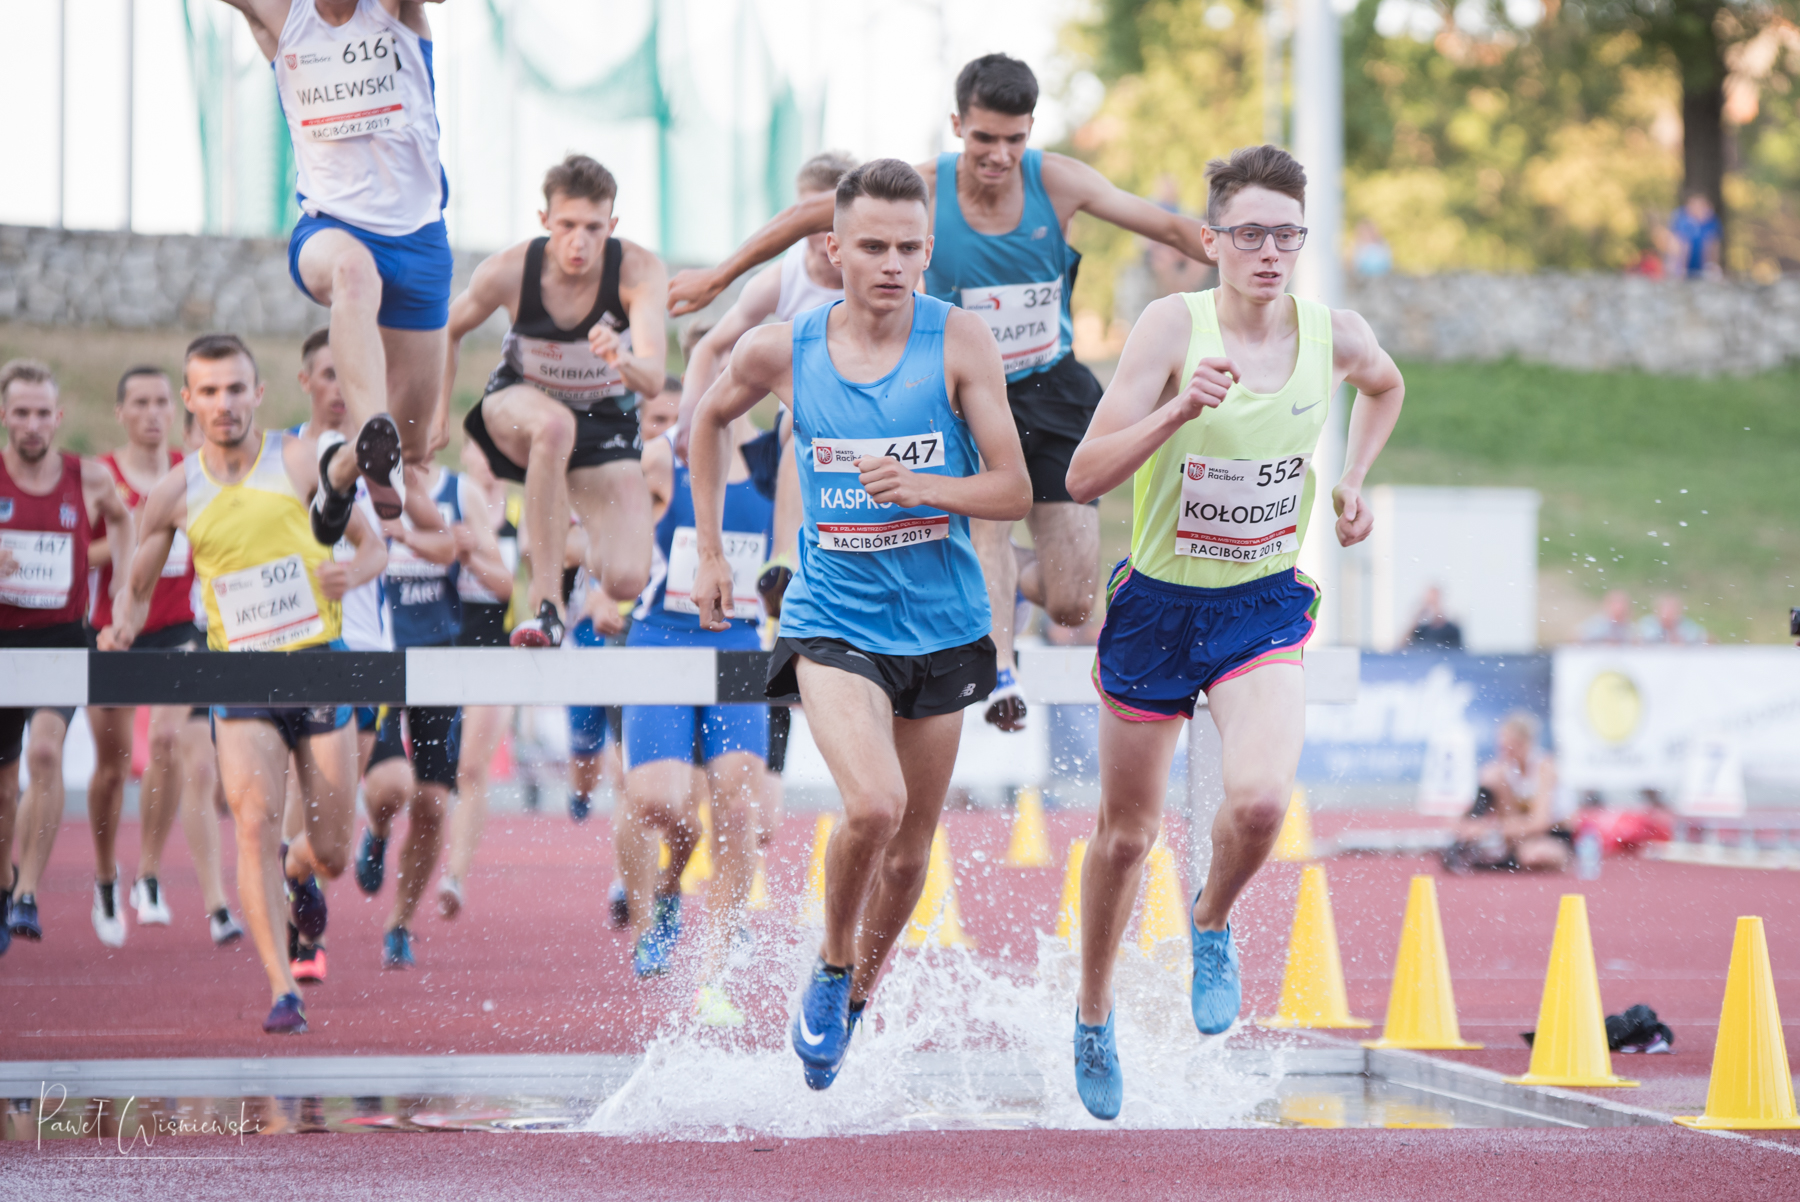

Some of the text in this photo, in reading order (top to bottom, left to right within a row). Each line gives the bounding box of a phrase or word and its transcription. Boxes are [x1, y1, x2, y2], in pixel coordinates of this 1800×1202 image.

[342, 37, 388, 65] 616
[296, 74, 395, 106] WALEWSKI
[311, 121, 362, 140] RACIBÓRZ
[364, 116, 390, 131] 2019
[540, 364, 607, 380] SKIBIAK
[883, 438, 938, 465] 647
[1207, 472, 1245, 482] Racibórz
[1256, 457, 1303, 487] 552
[820, 487, 894, 510] KASPR
[1184, 494, 1297, 524] KOŁODZIEJ
[833, 528, 932, 549] RACIBÓRZ 2019
[856, 524, 899, 532] MISTRZOSTWA
[34, 533, 67, 555] 447
[725, 539, 759, 559] 379
[1190, 540, 1282, 560] RACIBÓRZ 2019
[1217, 536, 1260, 545] MISTRZOSTWA
[261, 560, 300, 588] 502
[236, 591, 301, 626] JATCZAK
